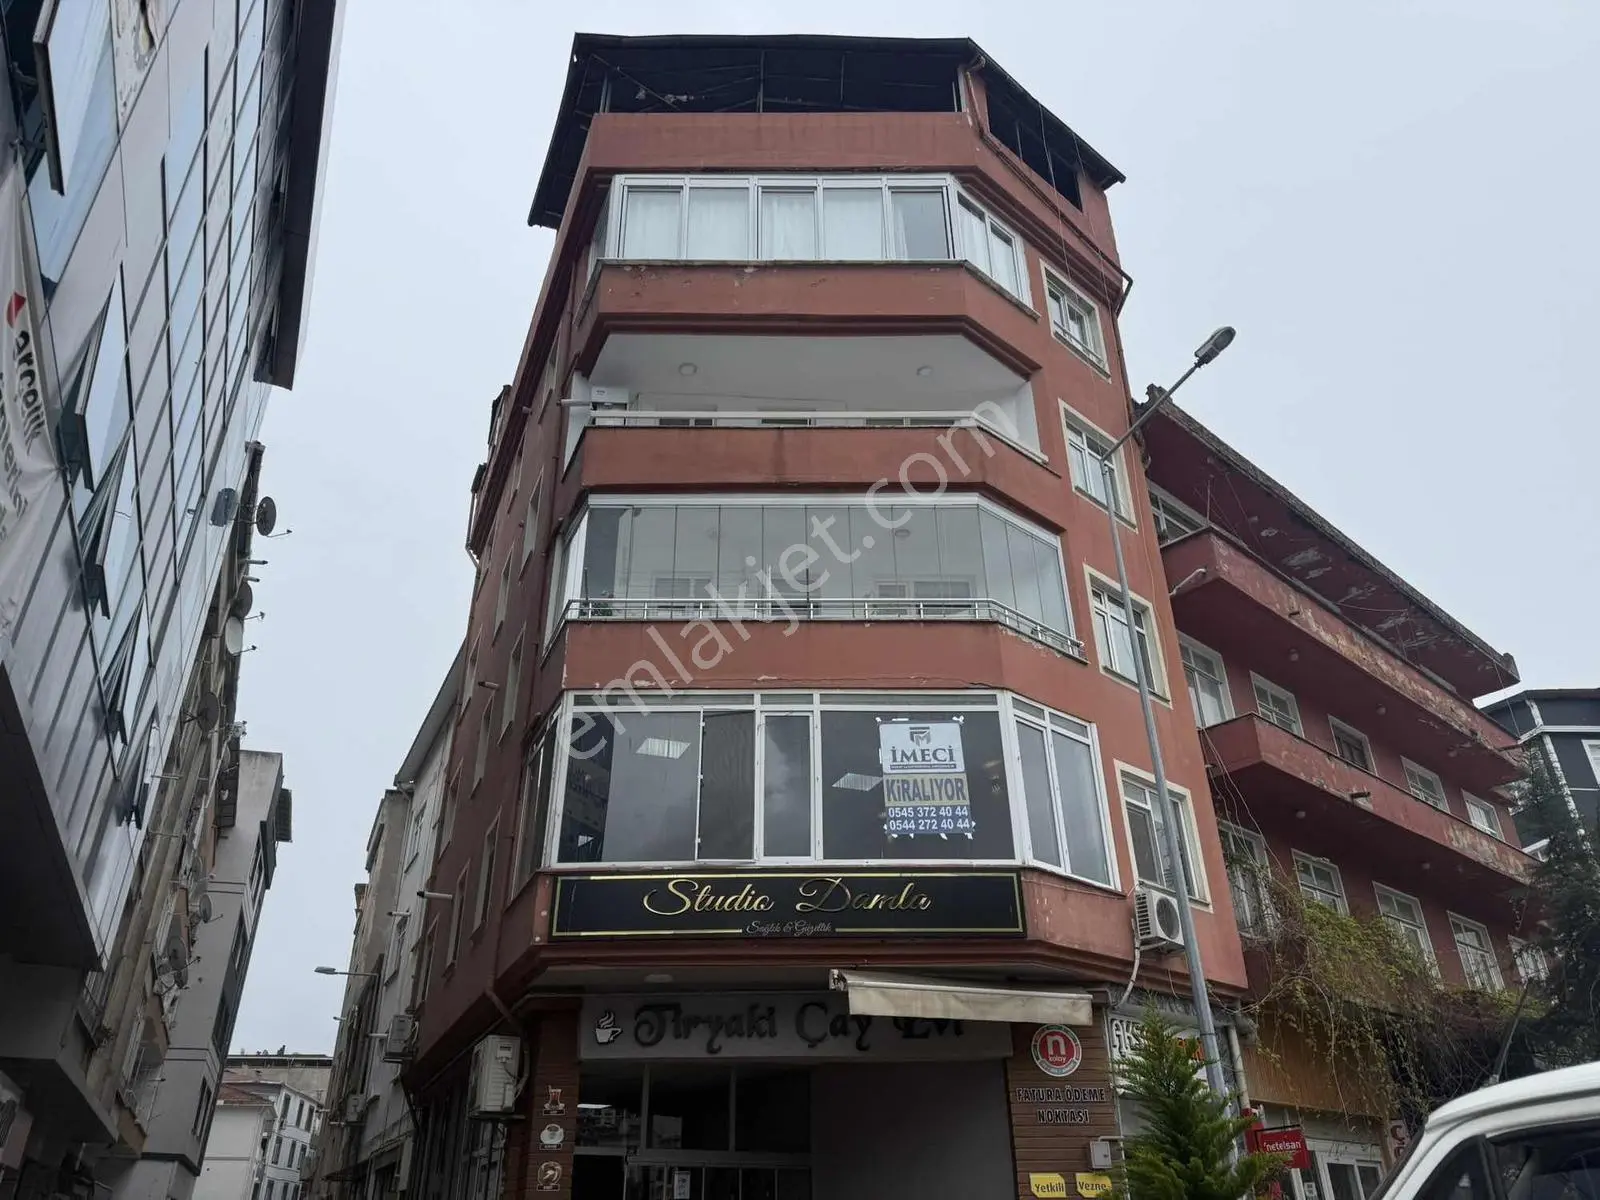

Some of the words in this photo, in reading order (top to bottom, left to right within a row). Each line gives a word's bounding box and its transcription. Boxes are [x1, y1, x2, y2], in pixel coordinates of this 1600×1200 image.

[888, 807, 914, 818] 0545
[917, 807, 937, 818] 372
[939, 806, 952, 817] 40
[955, 806, 969, 816] 44
[889, 819, 916, 831] 0544
[918, 819, 938, 830] 272
[940, 819, 954, 830] 40
[956, 818, 970, 829] 44
[643, 879, 775, 916] Studio
[795, 877, 932, 913] Damla
[1016, 1088, 1062, 1102] FATURA
[1064, 1084, 1105, 1102] ÖDEME
[1037, 1108, 1089, 1124] NOKTASI
[1034, 1183, 1065, 1193] Yetkili
[1078, 1181, 1107, 1191] Vezne
